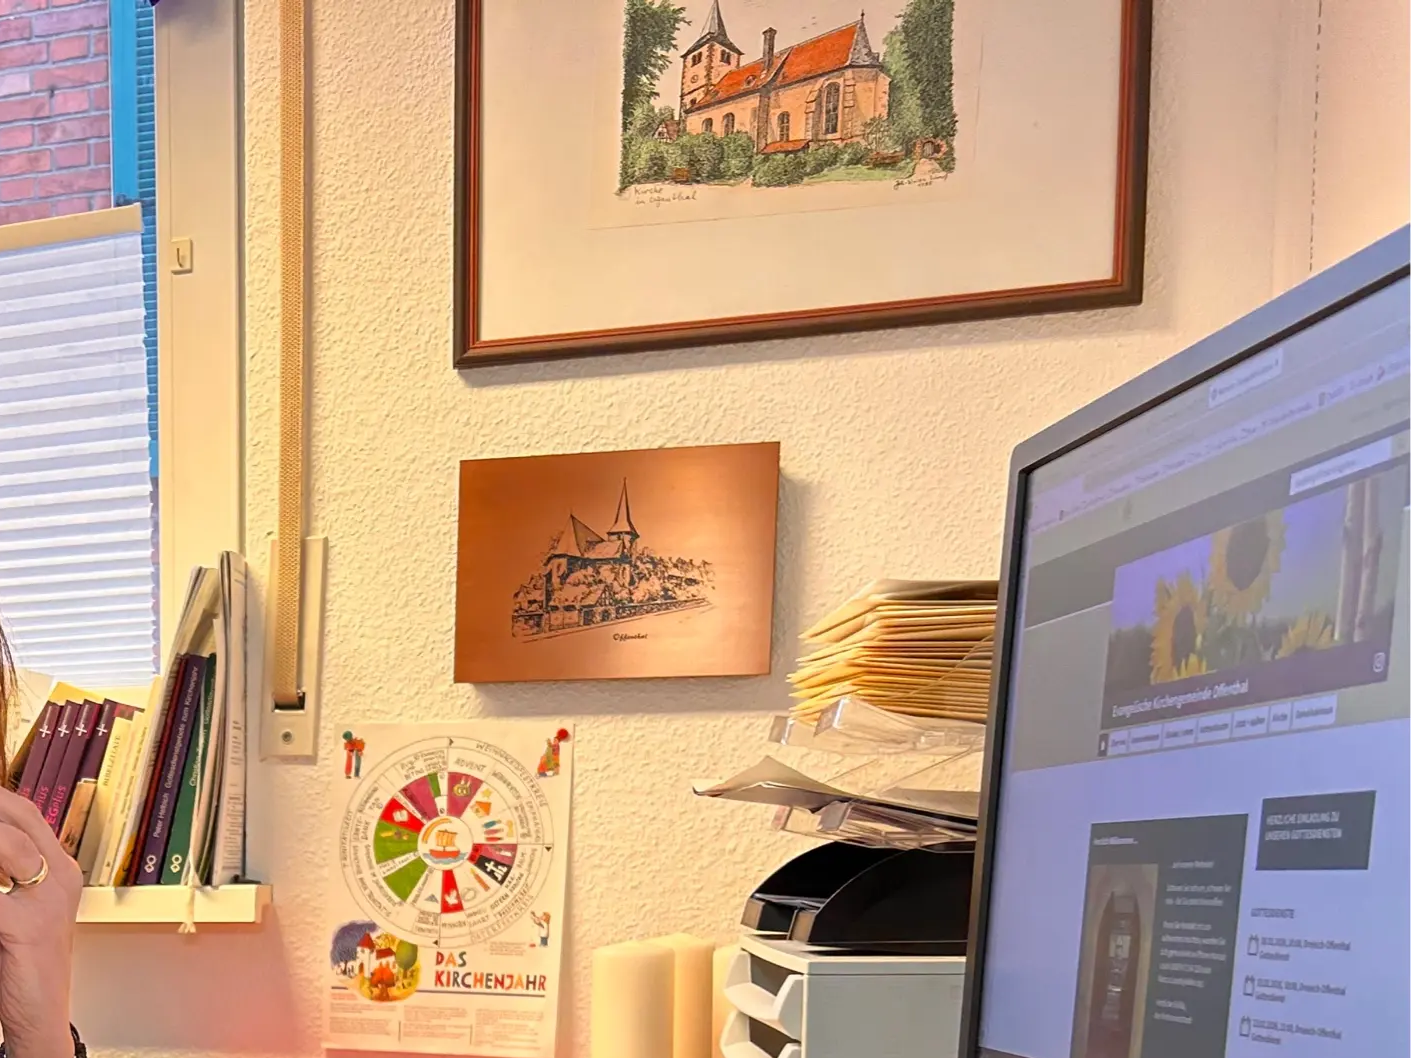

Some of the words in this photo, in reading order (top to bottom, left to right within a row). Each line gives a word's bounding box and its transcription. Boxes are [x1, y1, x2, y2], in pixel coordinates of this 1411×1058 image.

[454, 758, 487, 772] ADVENT
[435, 951, 467, 968] DAS
[435, 970, 547, 992] KIRCHENJAHR
